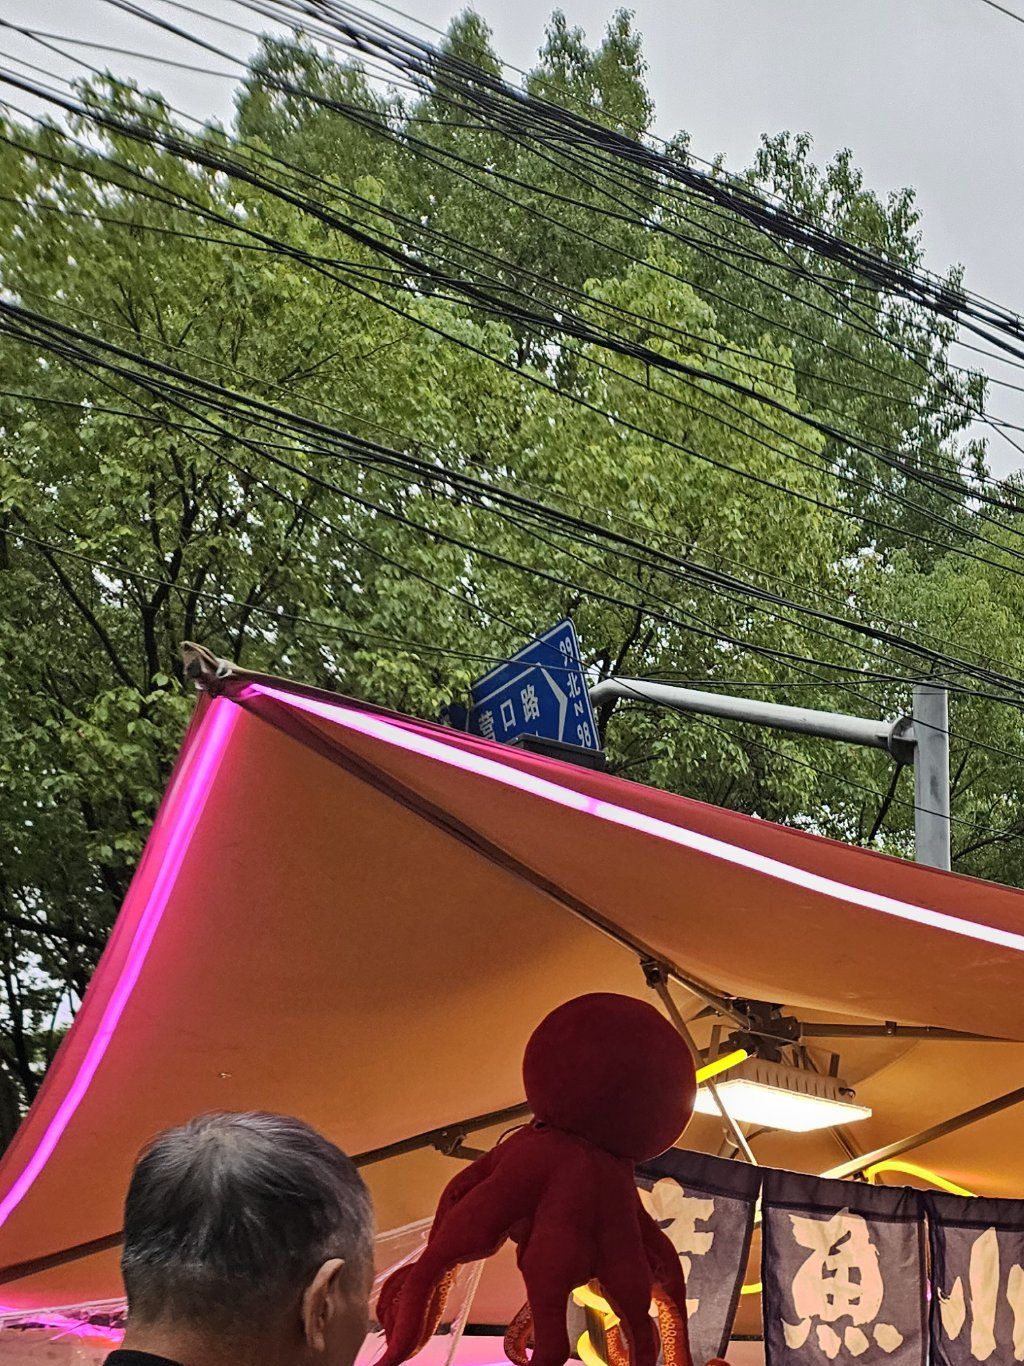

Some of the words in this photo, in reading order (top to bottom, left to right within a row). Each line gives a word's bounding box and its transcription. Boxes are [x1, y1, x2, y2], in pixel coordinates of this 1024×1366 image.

[559, 636, 574, 667] 99
[566, 672, 581, 699] 北
[479, 684, 540, 741] 营口路
[574, 700, 584, 717] N
[576, 721, 592, 747] 98
